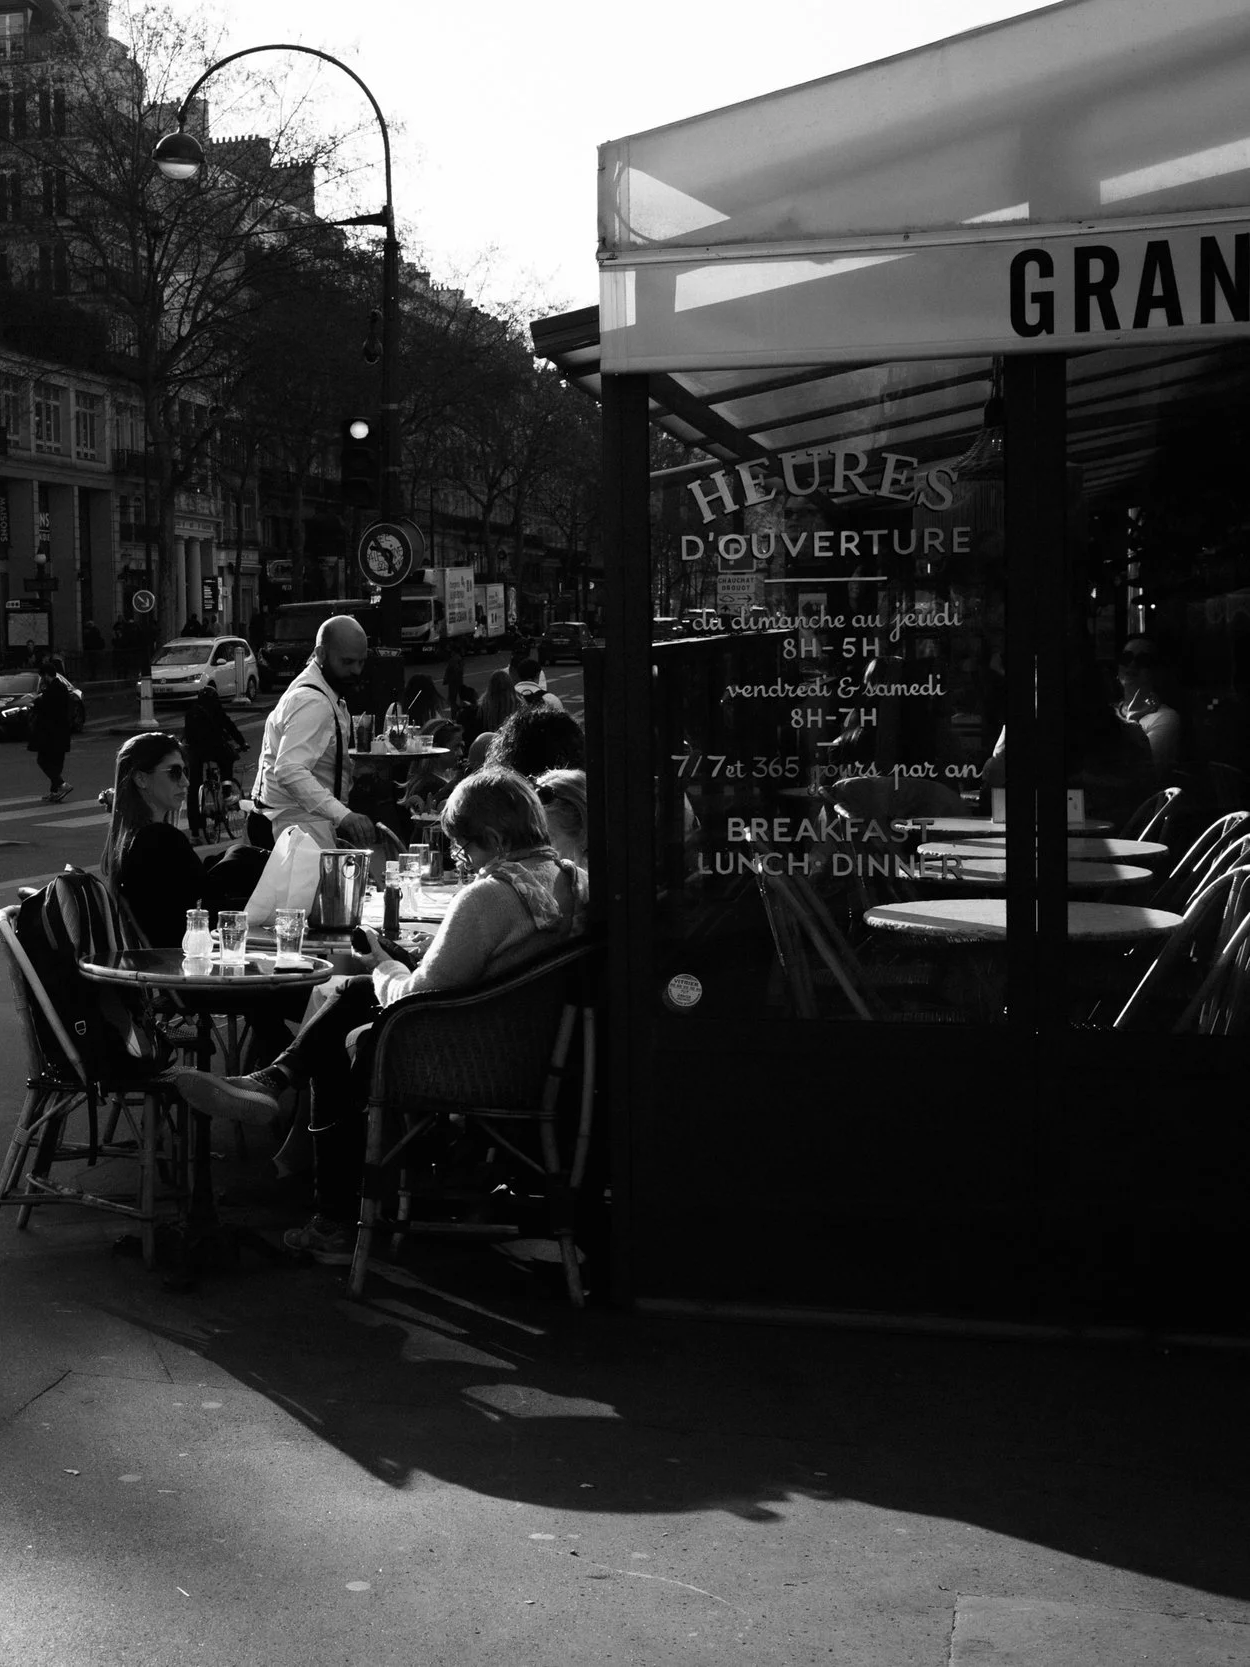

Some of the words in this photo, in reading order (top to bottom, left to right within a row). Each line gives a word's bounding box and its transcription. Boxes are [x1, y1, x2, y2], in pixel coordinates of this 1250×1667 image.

[1009, 232, 1250, 338] GRAN
[687, 448, 959, 524] HEURES
[0, 497, 8, 542] MAISONS
[681, 527, 971, 561] D'OUVERTURE
[692, 608, 725, 631] du
[731, 605, 846, 630] dimanche
[852, 613, 883, 629] au
[889, 601, 963, 642] jeudi
[725, 674, 832, 698] vendredi
[837, 677, 860, 697] &
[862, 674, 947, 697] samedi
[752, 756, 800, 778] 365
[890, 762, 936, 790] par
[944, 763, 983, 778] an
[727, 818, 935, 843] BREAKFAST
[697, 852, 810, 876] LUNCH
[833, 853, 962, 879] DINNER
